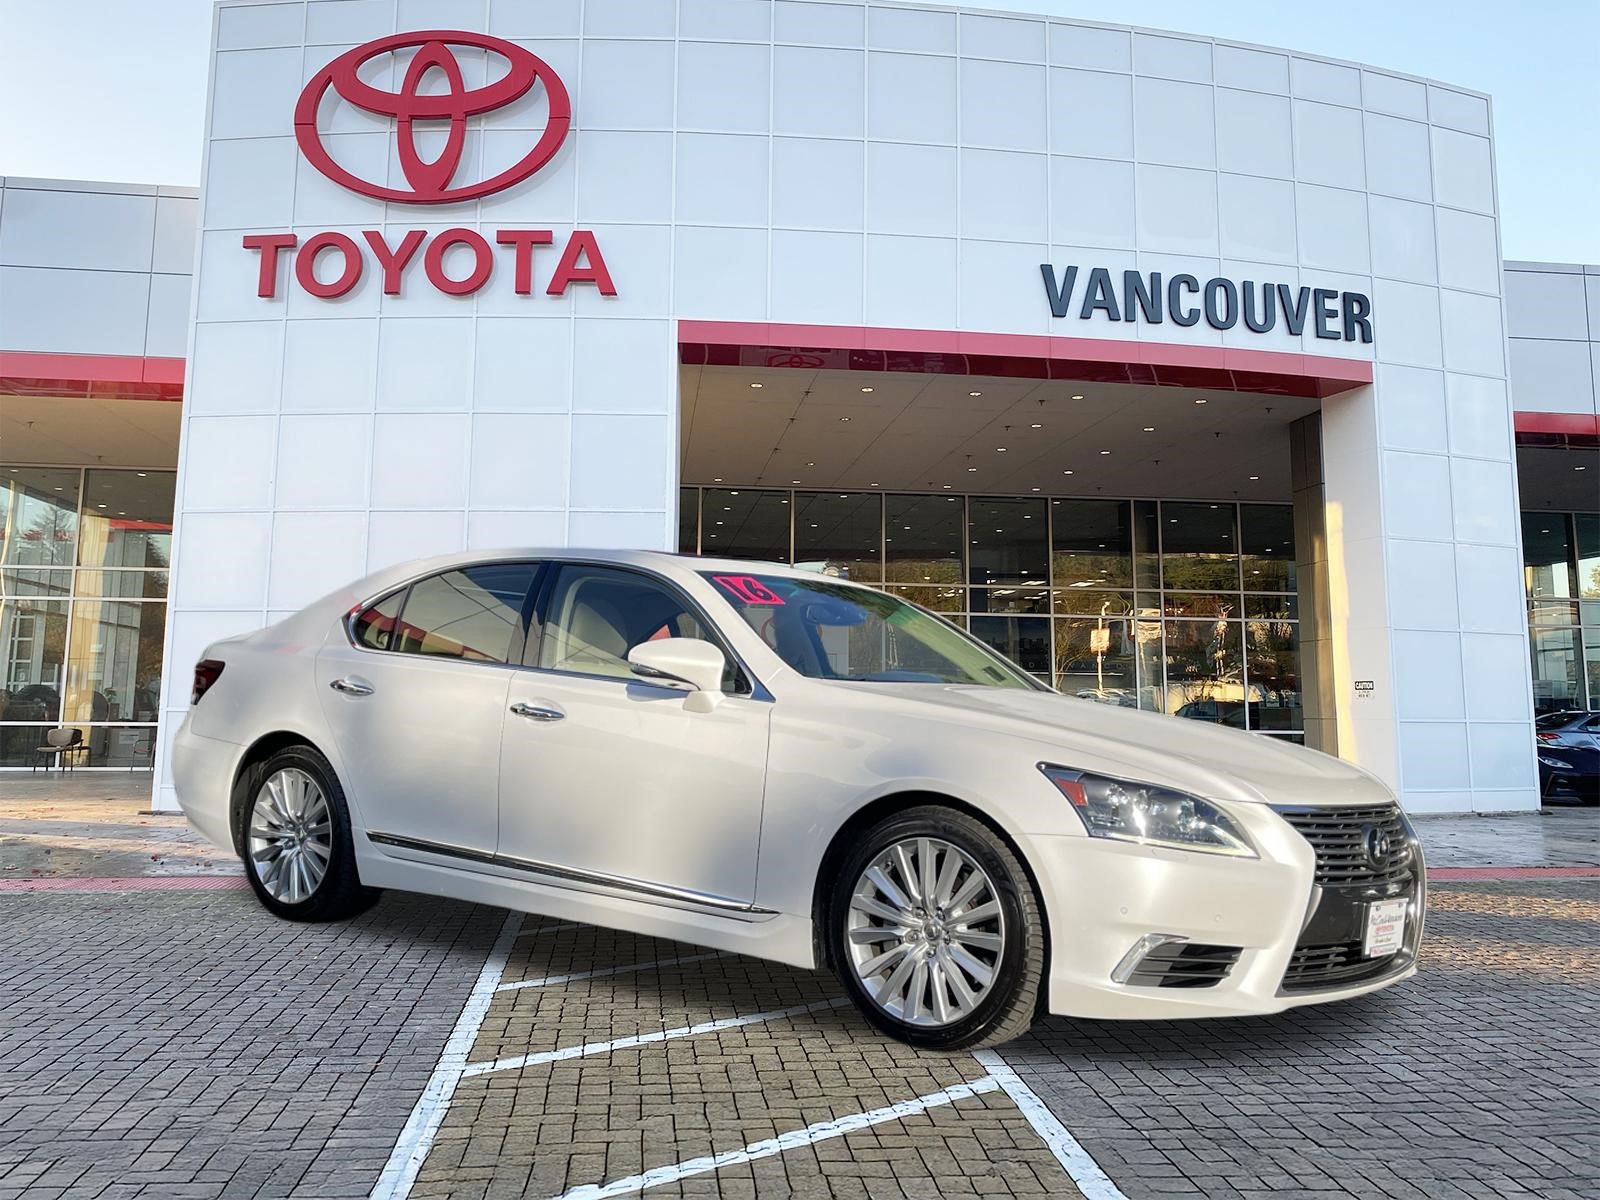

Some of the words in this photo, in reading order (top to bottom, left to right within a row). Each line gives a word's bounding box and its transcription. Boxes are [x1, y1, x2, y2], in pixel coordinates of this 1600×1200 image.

[243, 228, 617, 298] TOYOTA
[1040, 263, 1374, 345] VANCOUVER
[718, 577, 774, 602] 16
